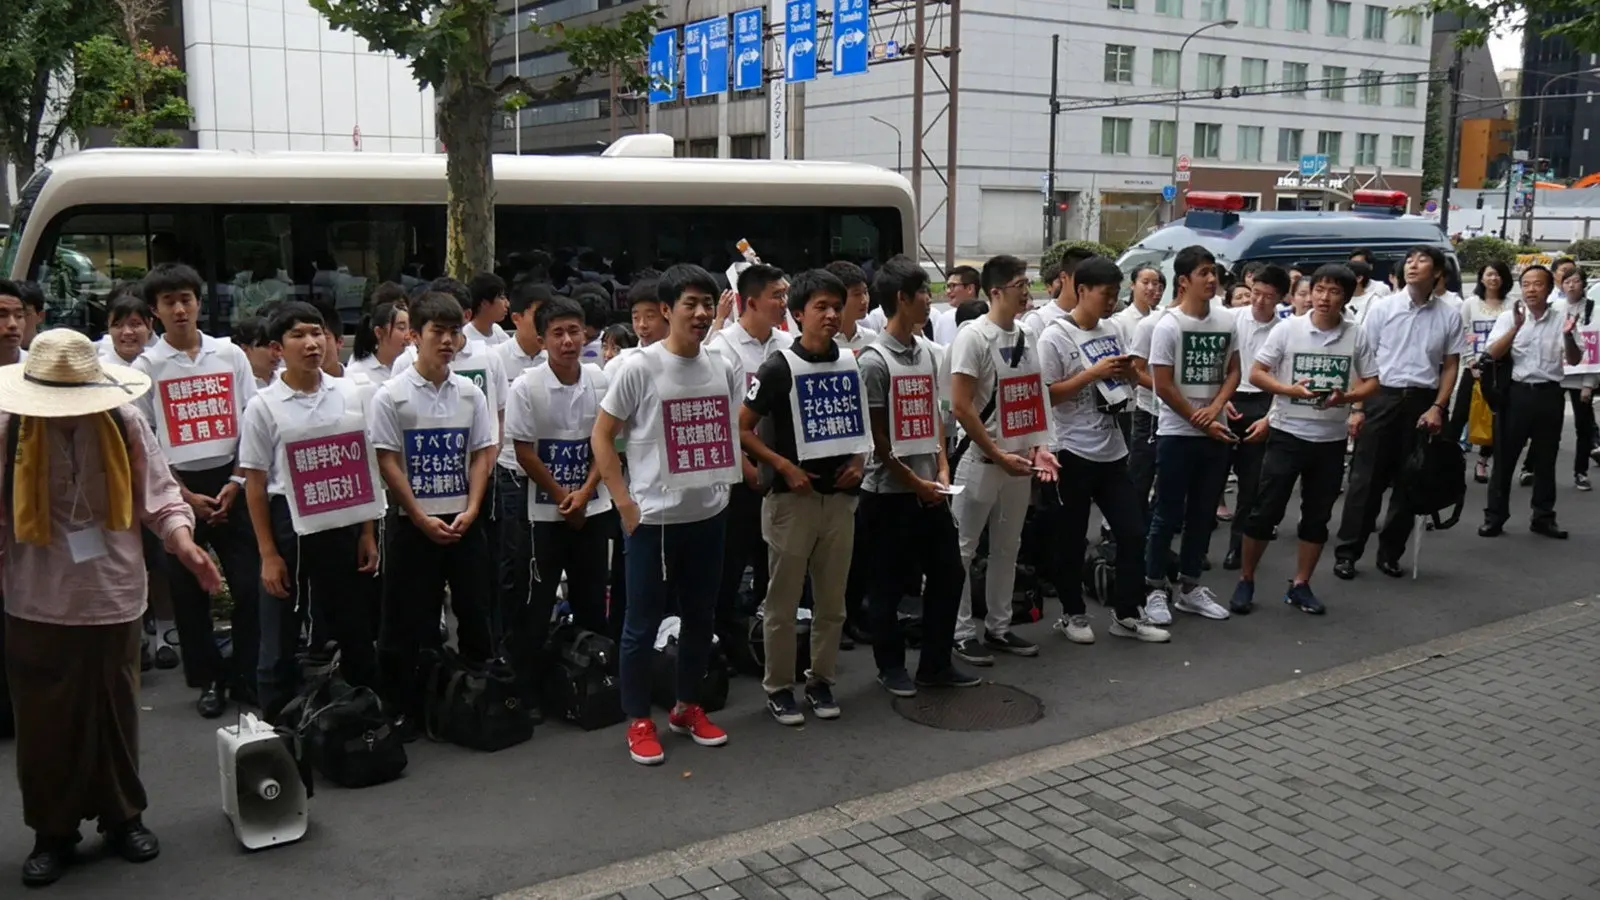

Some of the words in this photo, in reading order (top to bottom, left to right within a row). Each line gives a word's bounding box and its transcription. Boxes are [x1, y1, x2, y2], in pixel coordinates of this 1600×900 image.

[167, 376, 229, 401] 朝鮮学校に
[805, 375, 852, 396] すべての
[169, 397, 232, 421] 「高校無償化」
[670, 399, 723, 422] 朝鮮学校に
[804, 394, 858, 417] 子どもたちに
[671, 422, 727, 446] 「高校無償化」
[807, 415, 859, 438] 学ぶ権利を！
[414, 432, 465, 451] すべての
[294, 441, 361, 472] 朝鮮学校への
[303, 473, 362, 506] 差別反対！
